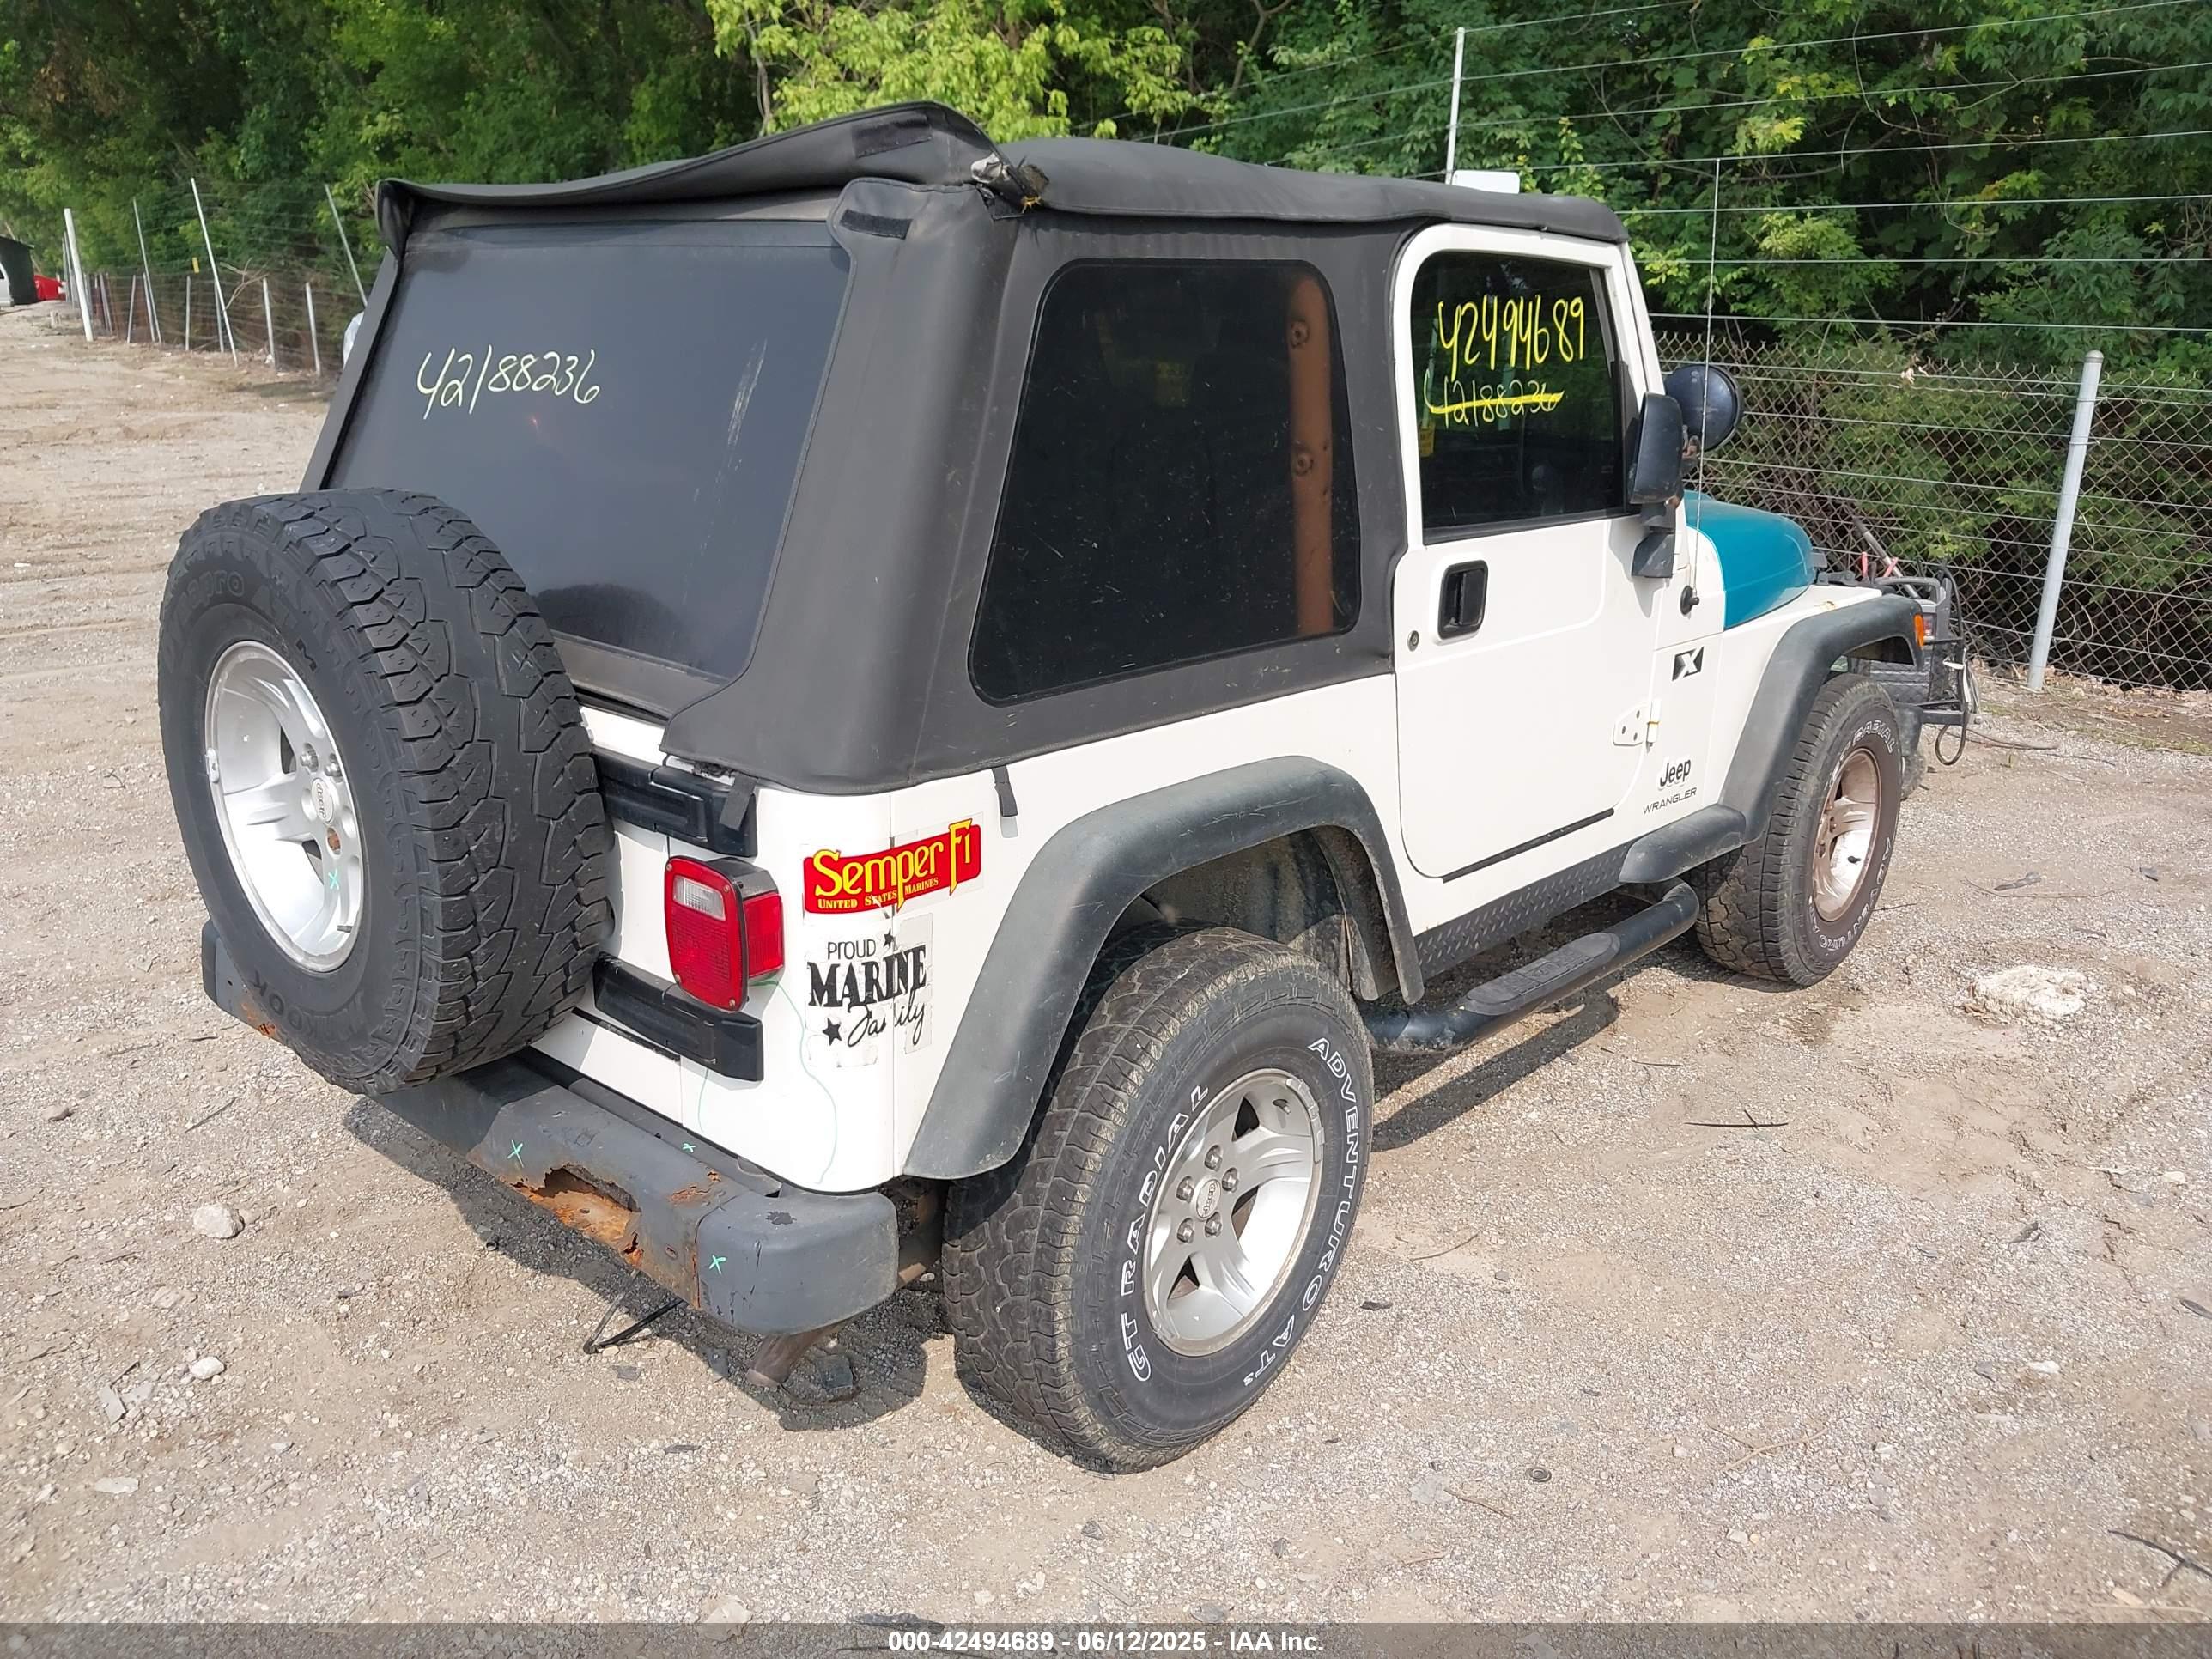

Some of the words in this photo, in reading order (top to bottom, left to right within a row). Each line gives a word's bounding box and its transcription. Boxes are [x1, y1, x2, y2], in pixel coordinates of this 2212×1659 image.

[1437, 294, 1584, 382] 42494689
[416, 343, 600, 420] 42188236
[1643, 787, 1698, 815] WRANGLER
[1659, 758, 1692, 787] Jeep
[812, 840, 945, 913] Semper
[817, 897, 858, 910] UNITED
[904, 877, 939, 896] MARINES
[806, 945, 928, 1007] MARINE
[847, 991, 925, 1048] Faily
[1120, 1085, 1209, 1297] RADIAL
[1303, 1037, 1359, 1311] ADVENTURO
[1121, 1311, 1152, 1382] GT
